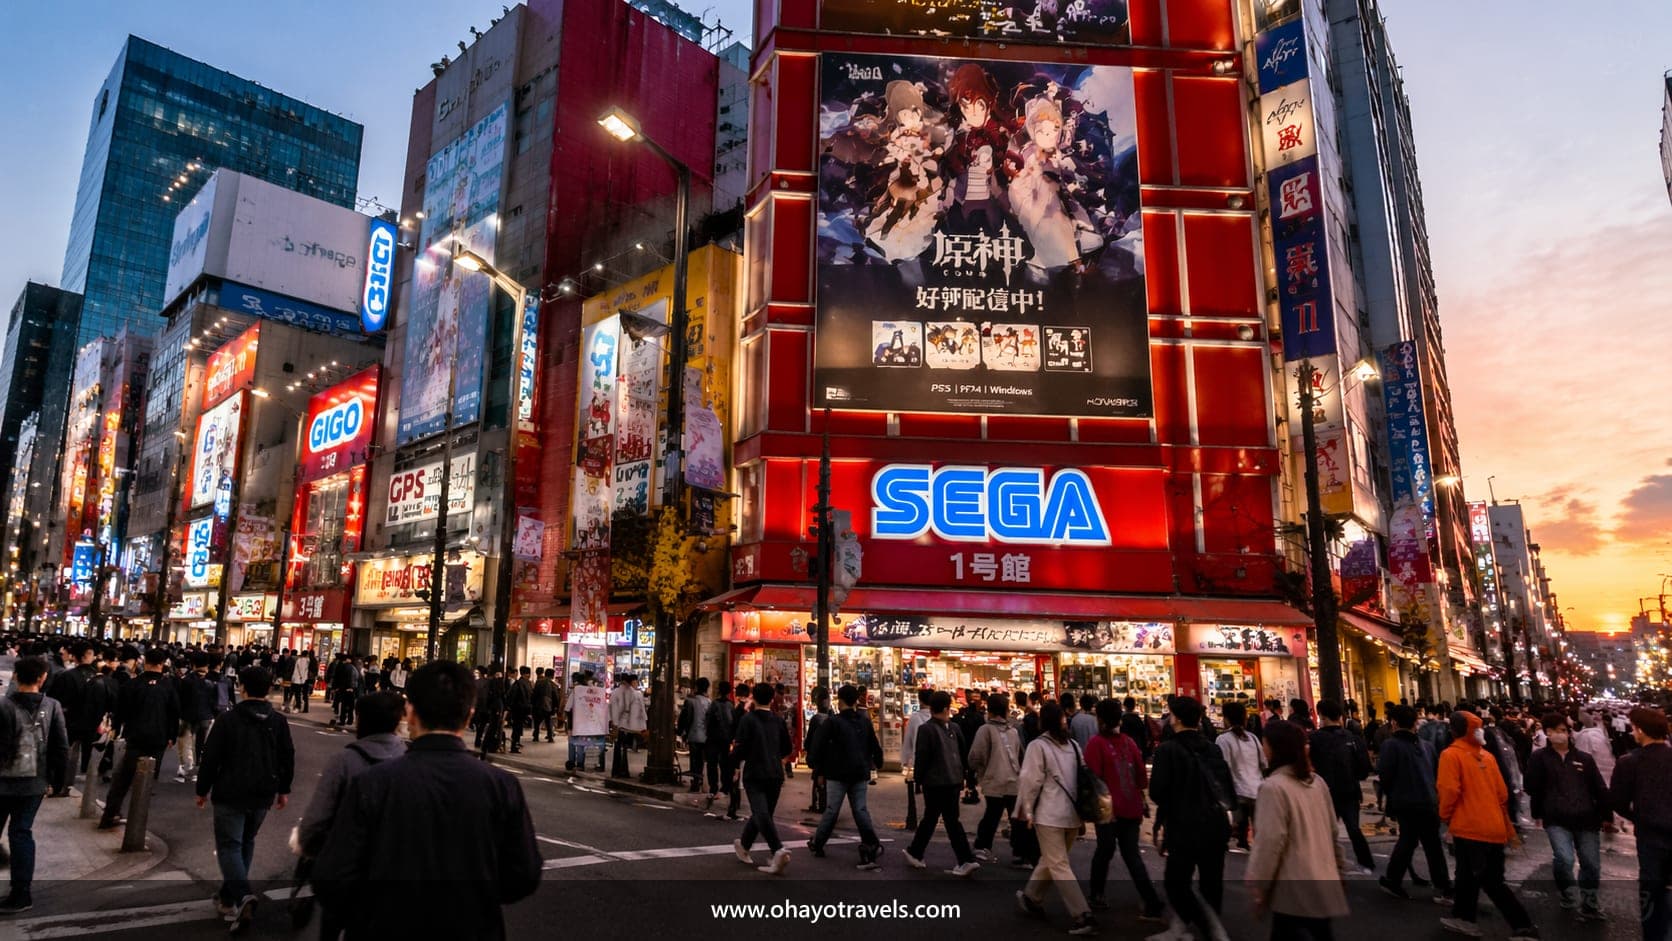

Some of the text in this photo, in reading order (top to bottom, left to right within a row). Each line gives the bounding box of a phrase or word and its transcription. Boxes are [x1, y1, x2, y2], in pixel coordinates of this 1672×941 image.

[310, 402, 361, 449] GIGO
[389, 469, 426, 504] GPS
[872, 464, 1112, 545] SEGA
[950, 553, 1031, 583] 1号館
